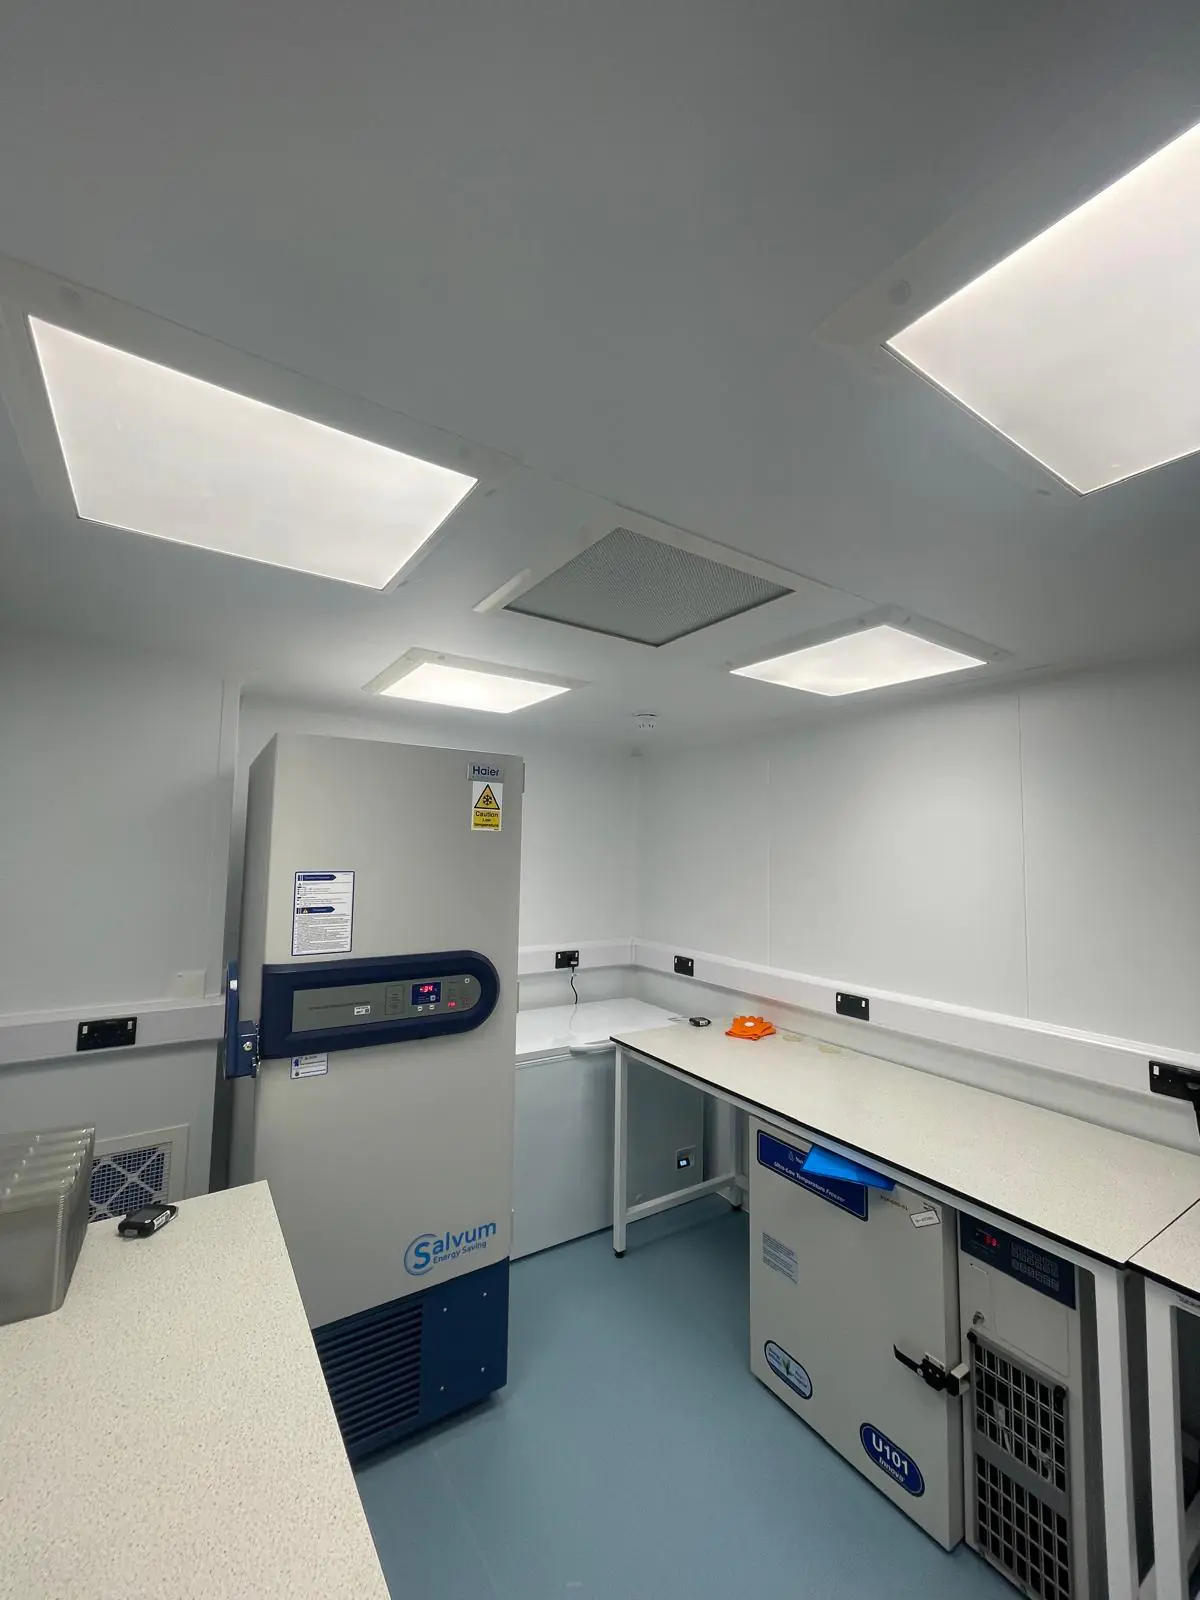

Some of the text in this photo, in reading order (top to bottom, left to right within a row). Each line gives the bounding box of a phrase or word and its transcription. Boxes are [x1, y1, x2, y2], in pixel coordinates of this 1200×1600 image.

[472, 765, 500, 776] Haier
[475, 810, 499, 818] Caution
[796, 1172, 826, 1193] Temperature
[826, 1189, 847, 1203] Freezer
[413, 1222, 497, 1270] Salvum
[433, 1241, 487, 1264] Energy Saving
[872, 1431, 909, 1476] U101
[879, 1456, 904, 1482] Innova
